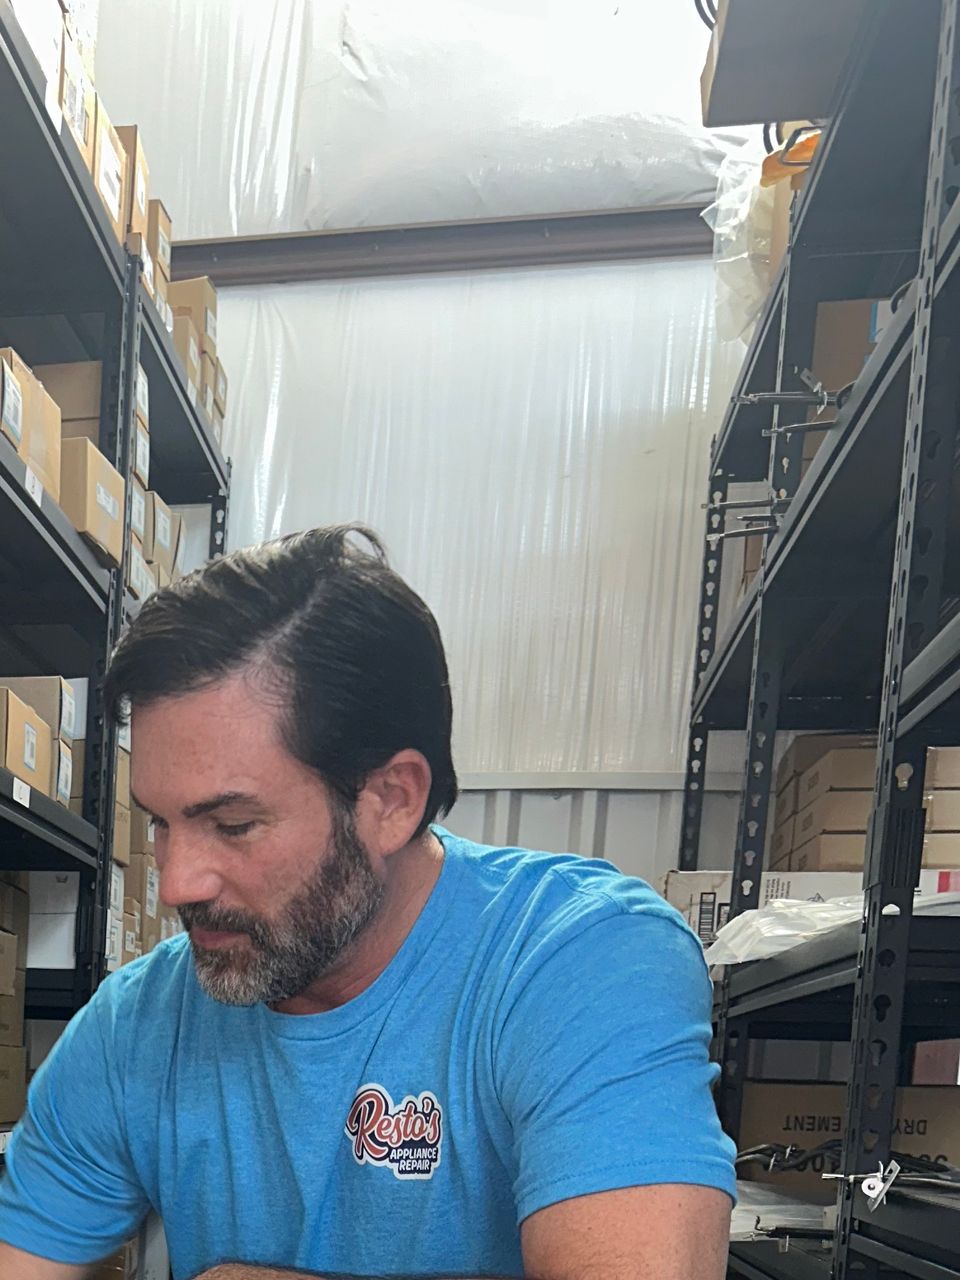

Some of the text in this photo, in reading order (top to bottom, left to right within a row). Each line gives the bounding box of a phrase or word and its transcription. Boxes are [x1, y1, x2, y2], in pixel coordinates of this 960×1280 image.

[347, 1090, 440, 1158] Resto's
[783, 1114, 928, 1136] DRY EMENT
[390, 1147, 437, 1160] APPLIANCE
[399, 1160, 430, 1171] REPAIR
